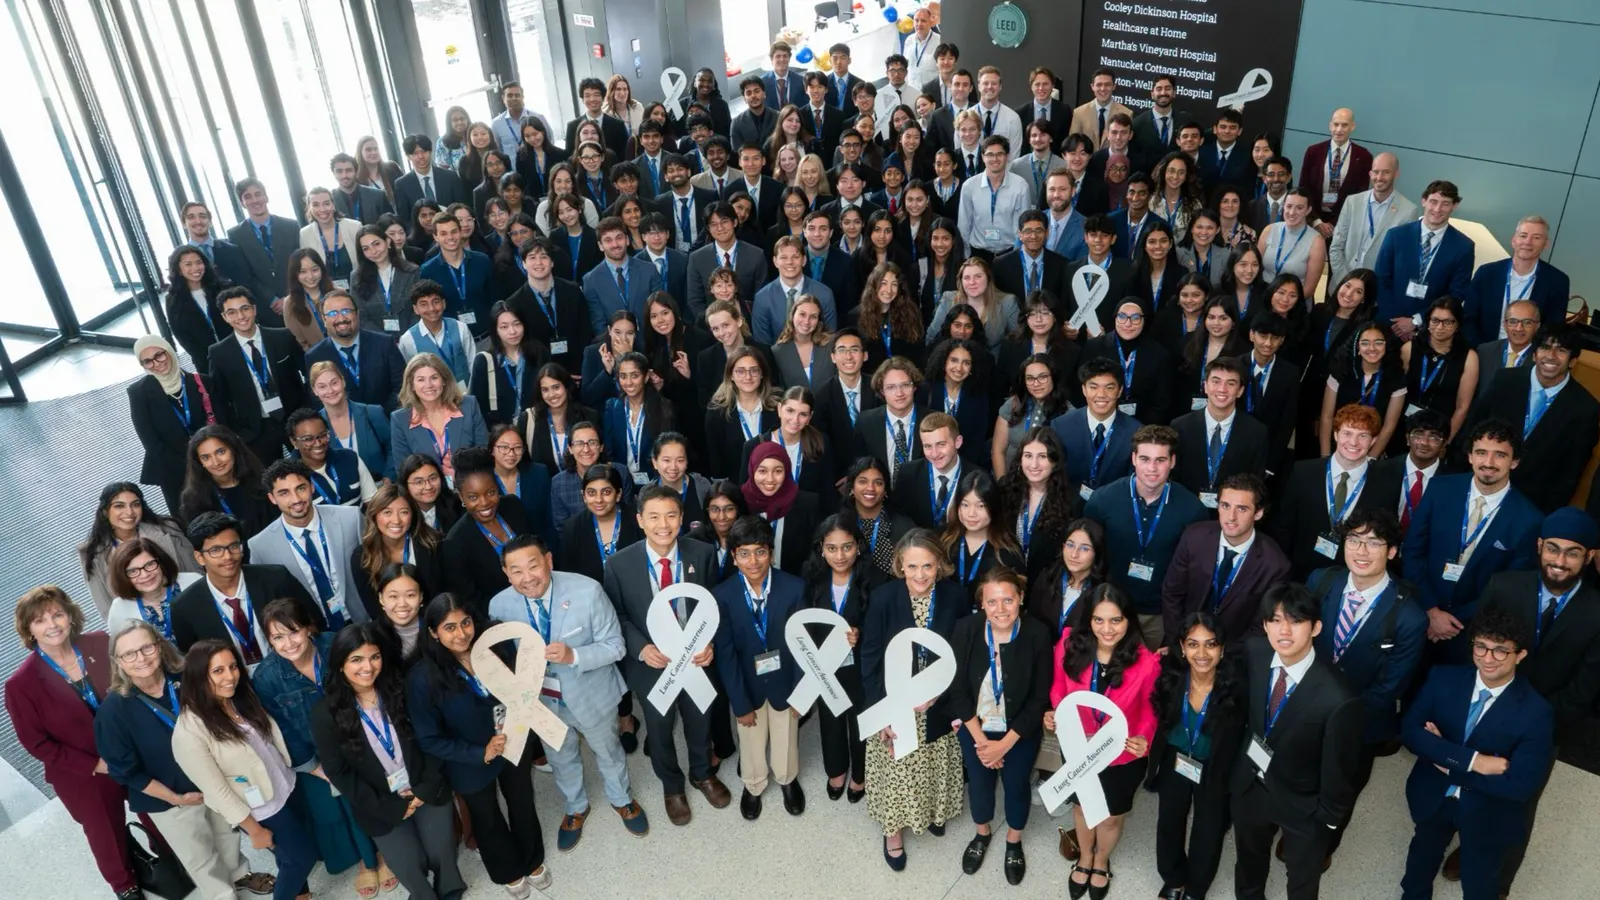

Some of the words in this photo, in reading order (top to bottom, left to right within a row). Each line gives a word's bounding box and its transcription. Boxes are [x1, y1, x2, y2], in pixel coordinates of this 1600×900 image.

[1104, 1, 1133, 15] Cooley
[1134, 4, 1178, 19] Dickinson
[1179, 10, 1217, 24] Hospital
[996, 19, 1017, 31] LEED
[1102, 20, 1148, 34] Healthcare
[1150, 27, 1159, 35] at
[1160, 27, 1187, 39] Home
[1101, 38, 1137, 52] Martha's
[1139, 43, 1178, 57] Vineyard
[1180, 49, 1217, 63] Hospital
[1100, 56, 1143, 71] Nantucket
[1144, 62, 1177, 76] Cottage
[1179, 67, 1216, 81] Hospital
[1124, 95, 1156, 109] Hospita
[1176, 85, 1213, 100] Hospital
[796, 636, 808, 652] Lung
[806, 651, 821, 671] Cancer
[659, 677, 675, 695] Lung
[670, 654, 687, 677] Cancer
[1053, 779, 1071, 794] Lung
[1067, 761, 1087, 780] Cancer
